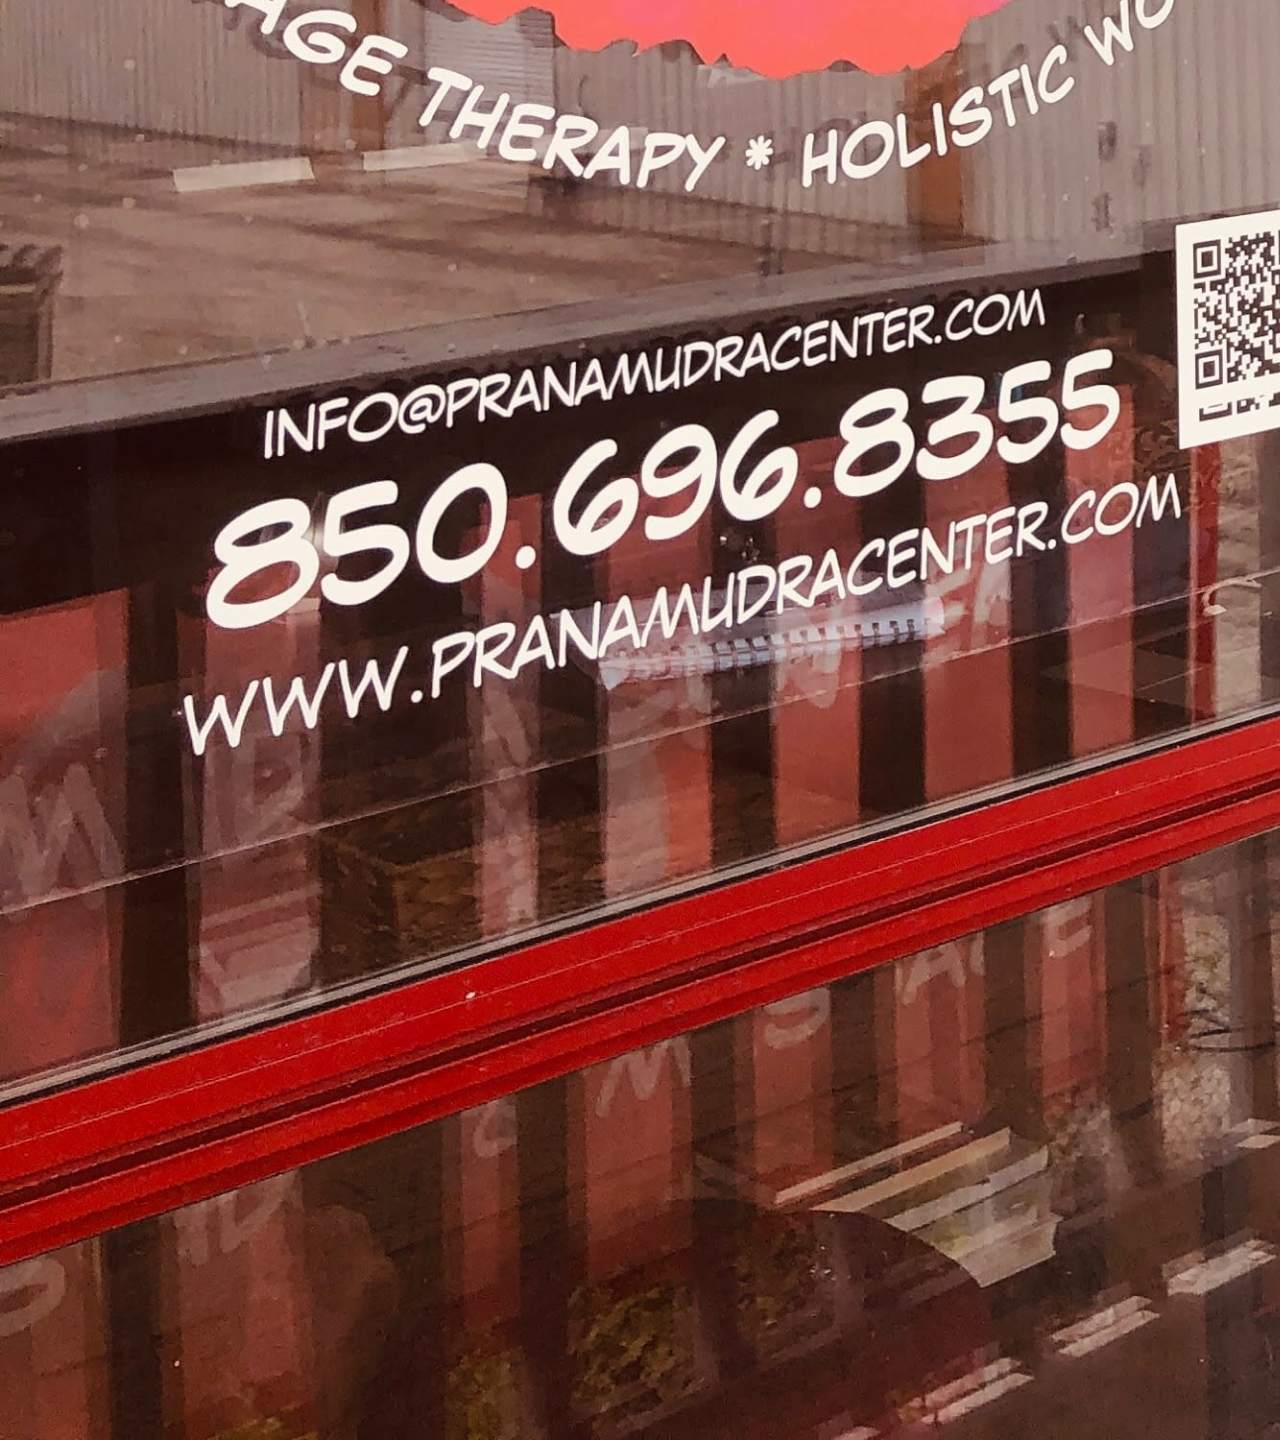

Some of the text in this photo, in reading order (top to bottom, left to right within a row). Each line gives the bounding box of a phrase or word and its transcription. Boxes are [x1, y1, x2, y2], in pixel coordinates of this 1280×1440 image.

[419, 67, 726, 192] THERAPY
[802, 44, 1075, 188] HOLISTIC
[264, 288, 1046, 460] INFO@PRANAMUDRACENTER.COM
[205, 349, 1121, 630] 850.696.8355
[183, 473, 1182, 756] WWW.PRANAMUDRACENTER.COM
